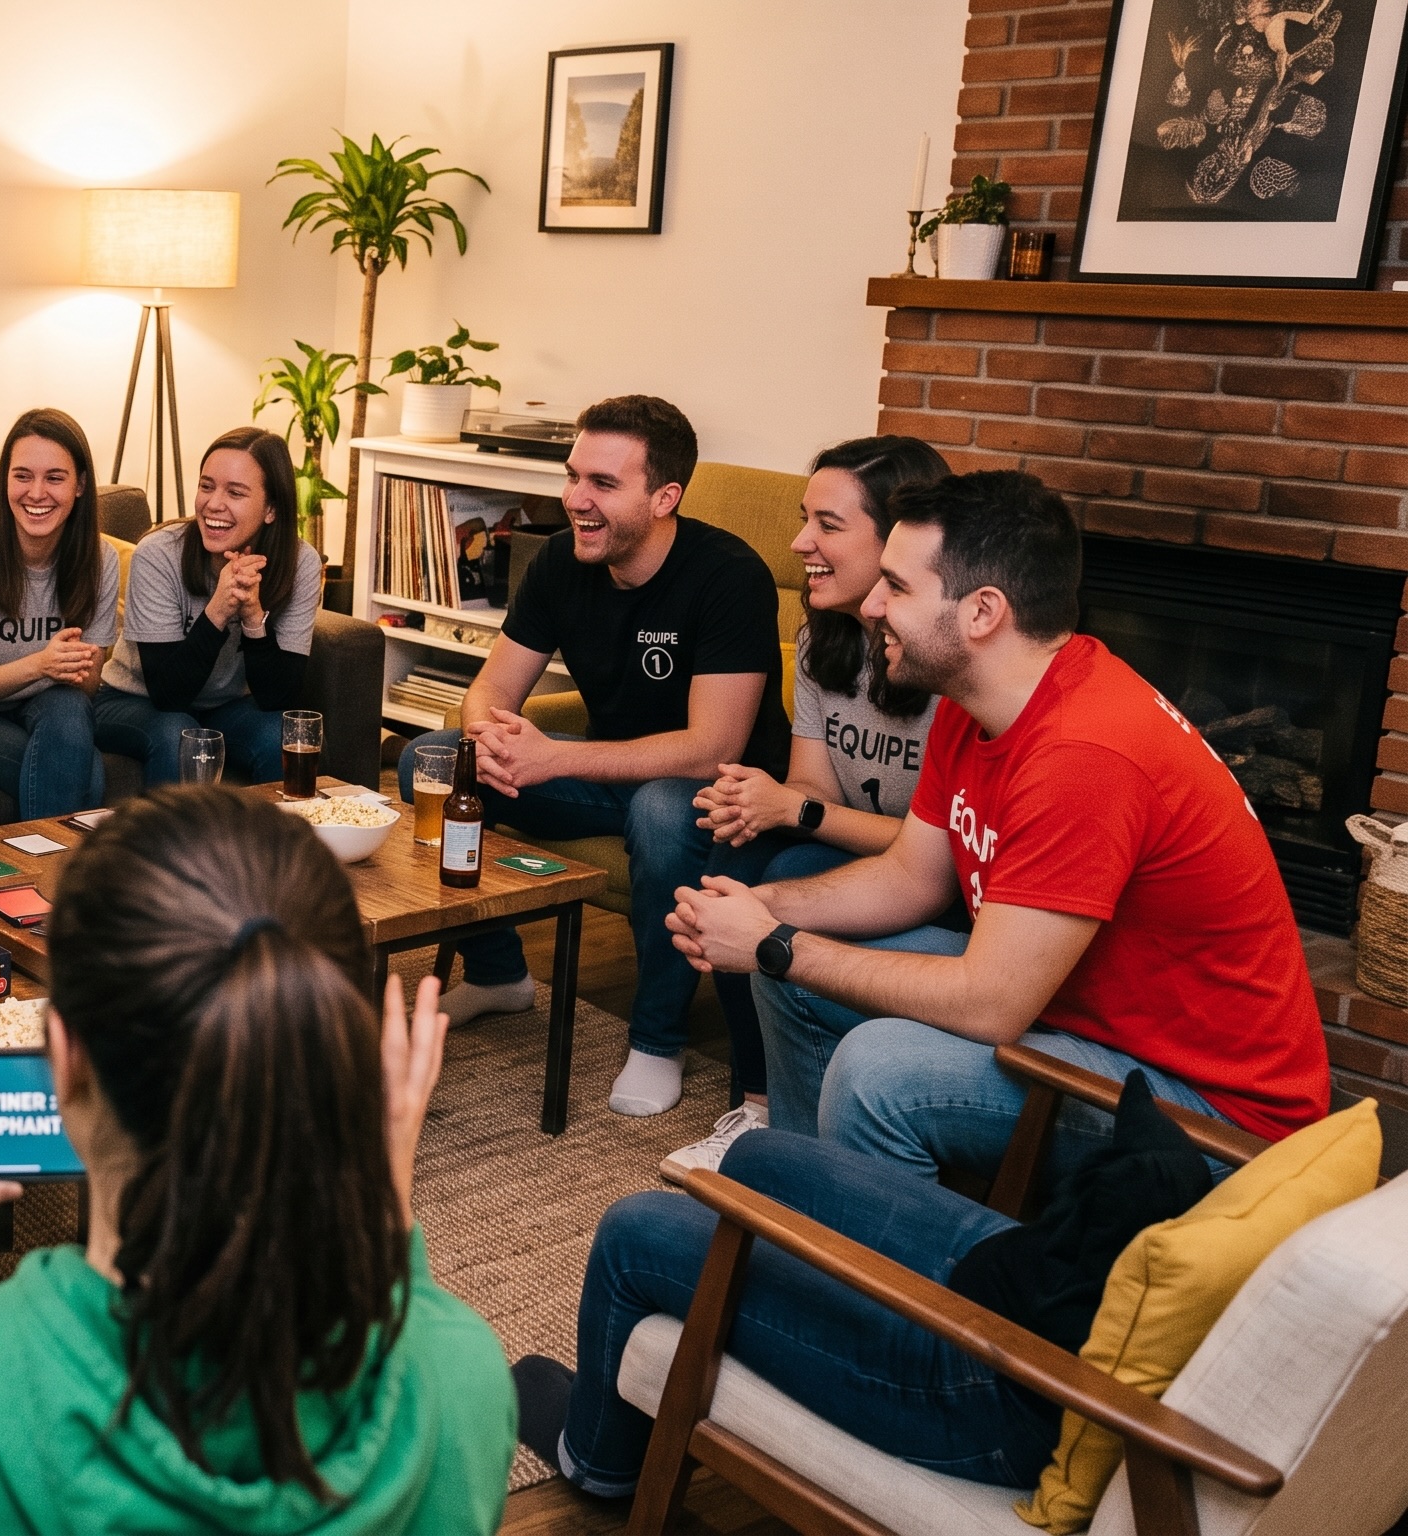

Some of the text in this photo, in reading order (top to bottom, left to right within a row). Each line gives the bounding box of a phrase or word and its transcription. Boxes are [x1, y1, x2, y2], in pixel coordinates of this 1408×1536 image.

[637, 629, 679, 645] ÉQUIPE
[825, 712, 920, 771] ÉQUIPE
[860, 777, 884, 815] 1
